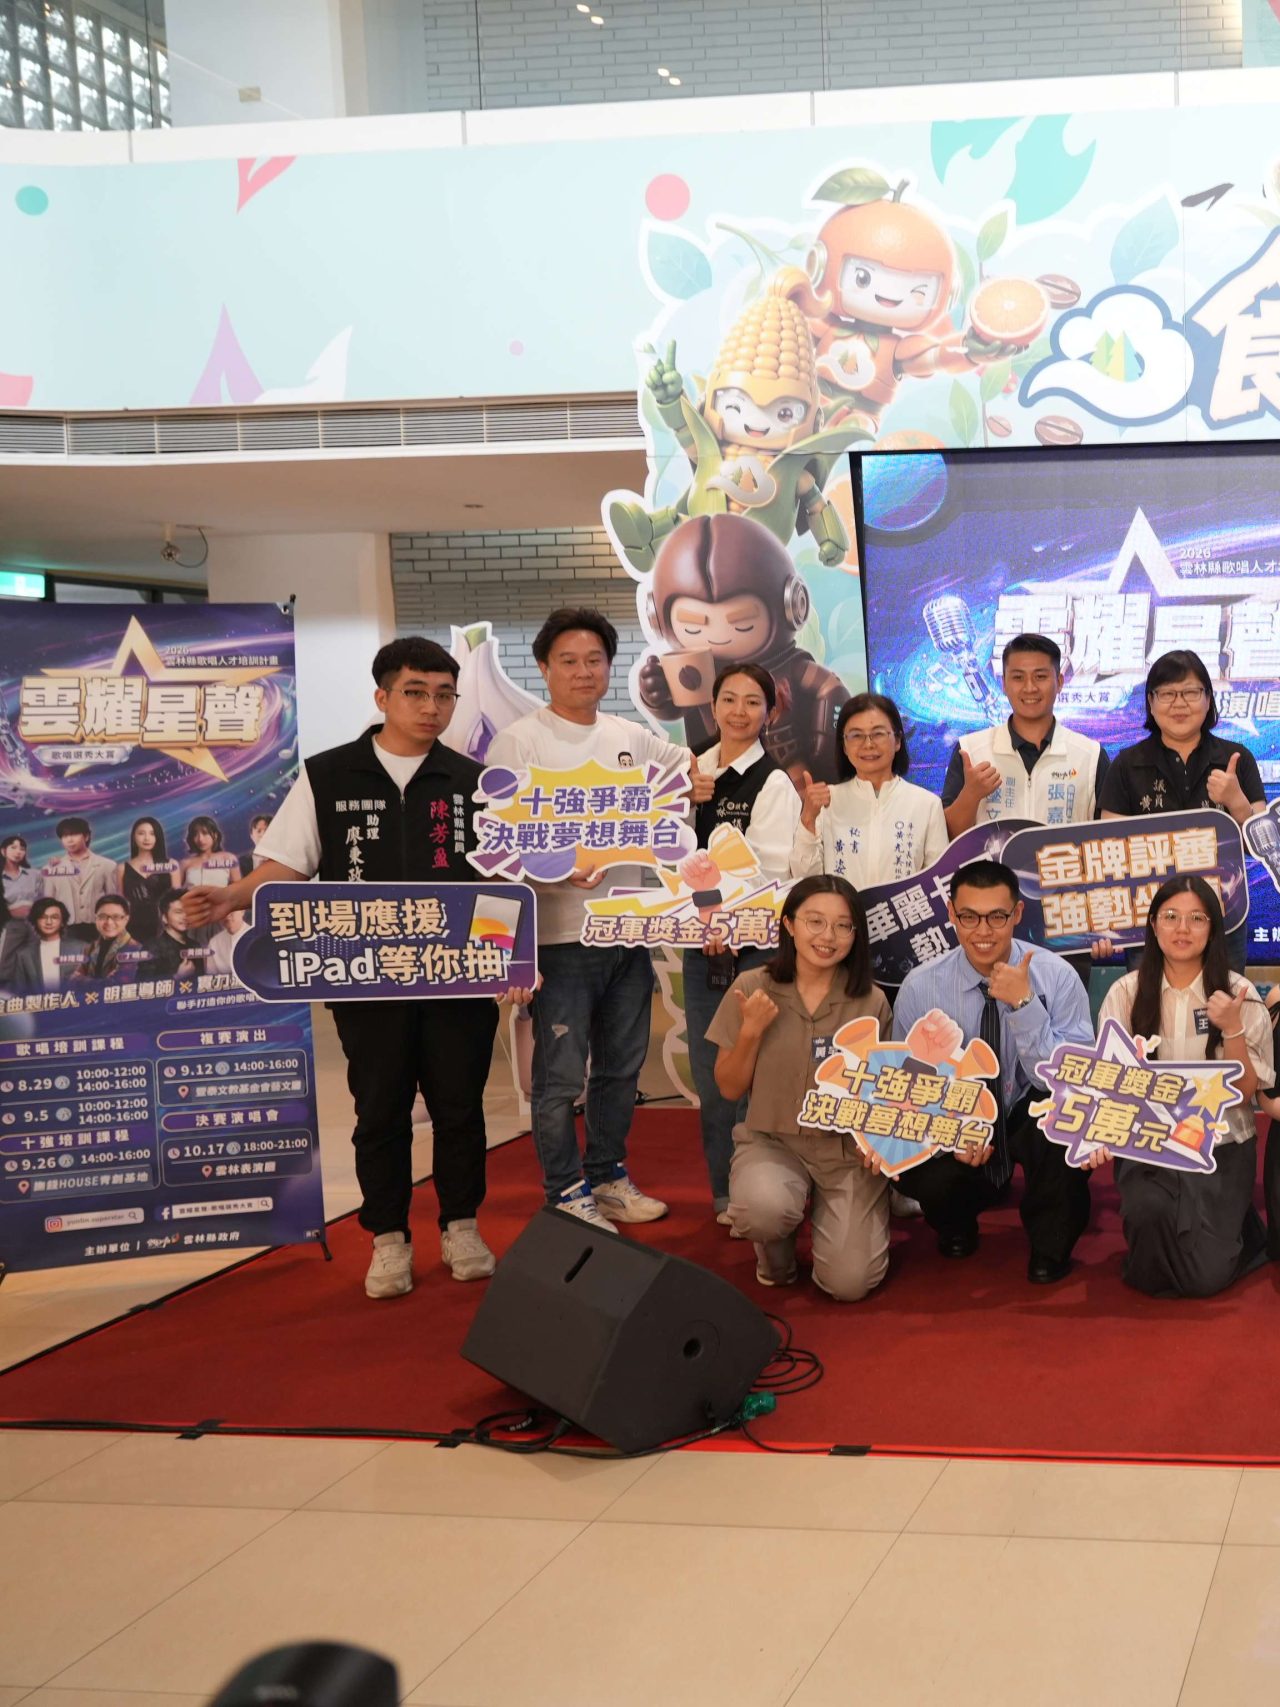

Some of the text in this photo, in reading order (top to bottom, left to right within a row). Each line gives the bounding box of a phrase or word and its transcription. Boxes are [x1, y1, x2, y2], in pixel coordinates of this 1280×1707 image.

[1179, 548, 1212, 559] 2026
[19, 675, 264, 746] 雲耀星聲
[335, 799, 387, 812] 服務團隊
[520, 785, 652, 816] 十強爭霸
[366, 813, 380, 840] 助理
[481, 819, 681, 851] 決戰夢想舞台
[1036, 827, 1219, 889] 金牌評審
[269, 897, 446, 941] 到場應援
[1041, 875, 1226, 939] 強勢坐
[585, 907, 779, 945] 冠軍獎金5萬
[278, 941, 507, 985] iPad等你抽
[0, 991, 80, 1014] 曲製作人
[104, 979, 175, 1002] 明星導師
[176, 991, 260, 1011] 聯手打造你的歌唱
[16, 1037, 125, 1056] 歌唱培訓課程
[200, 1029, 267, 1046] 複賽演出
[18, 1065, 147, 1092] 8.29 10:00-12:00
[180, 1058, 299, 1077] 9.12 14:00-16:00
[1055, 1054, 1186, 1105] 冠軍獎金
[77, 1078, 147, 1092] 14:00-16:00
[842, 1061, 983, 1114] 十強爭霸
[24, 1097, 148, 1123] 9.5 10:00-12:00
[79, 1110, 149, 1125] 14:00-16:00
[195, 1108, 279, 1127] 決賽演唱會
[801, 1093, 992, 1151] 決戰夢想舞台
[1053, 1092, 1171, 1153] 5萬元
[21, 1128, 130, 1150] 十強培訓課程
[184, 1138, 308, 1158] 10.17 18:00-21:00
[22, 1148, 151, 1171] 9.26 14:00-16:00
